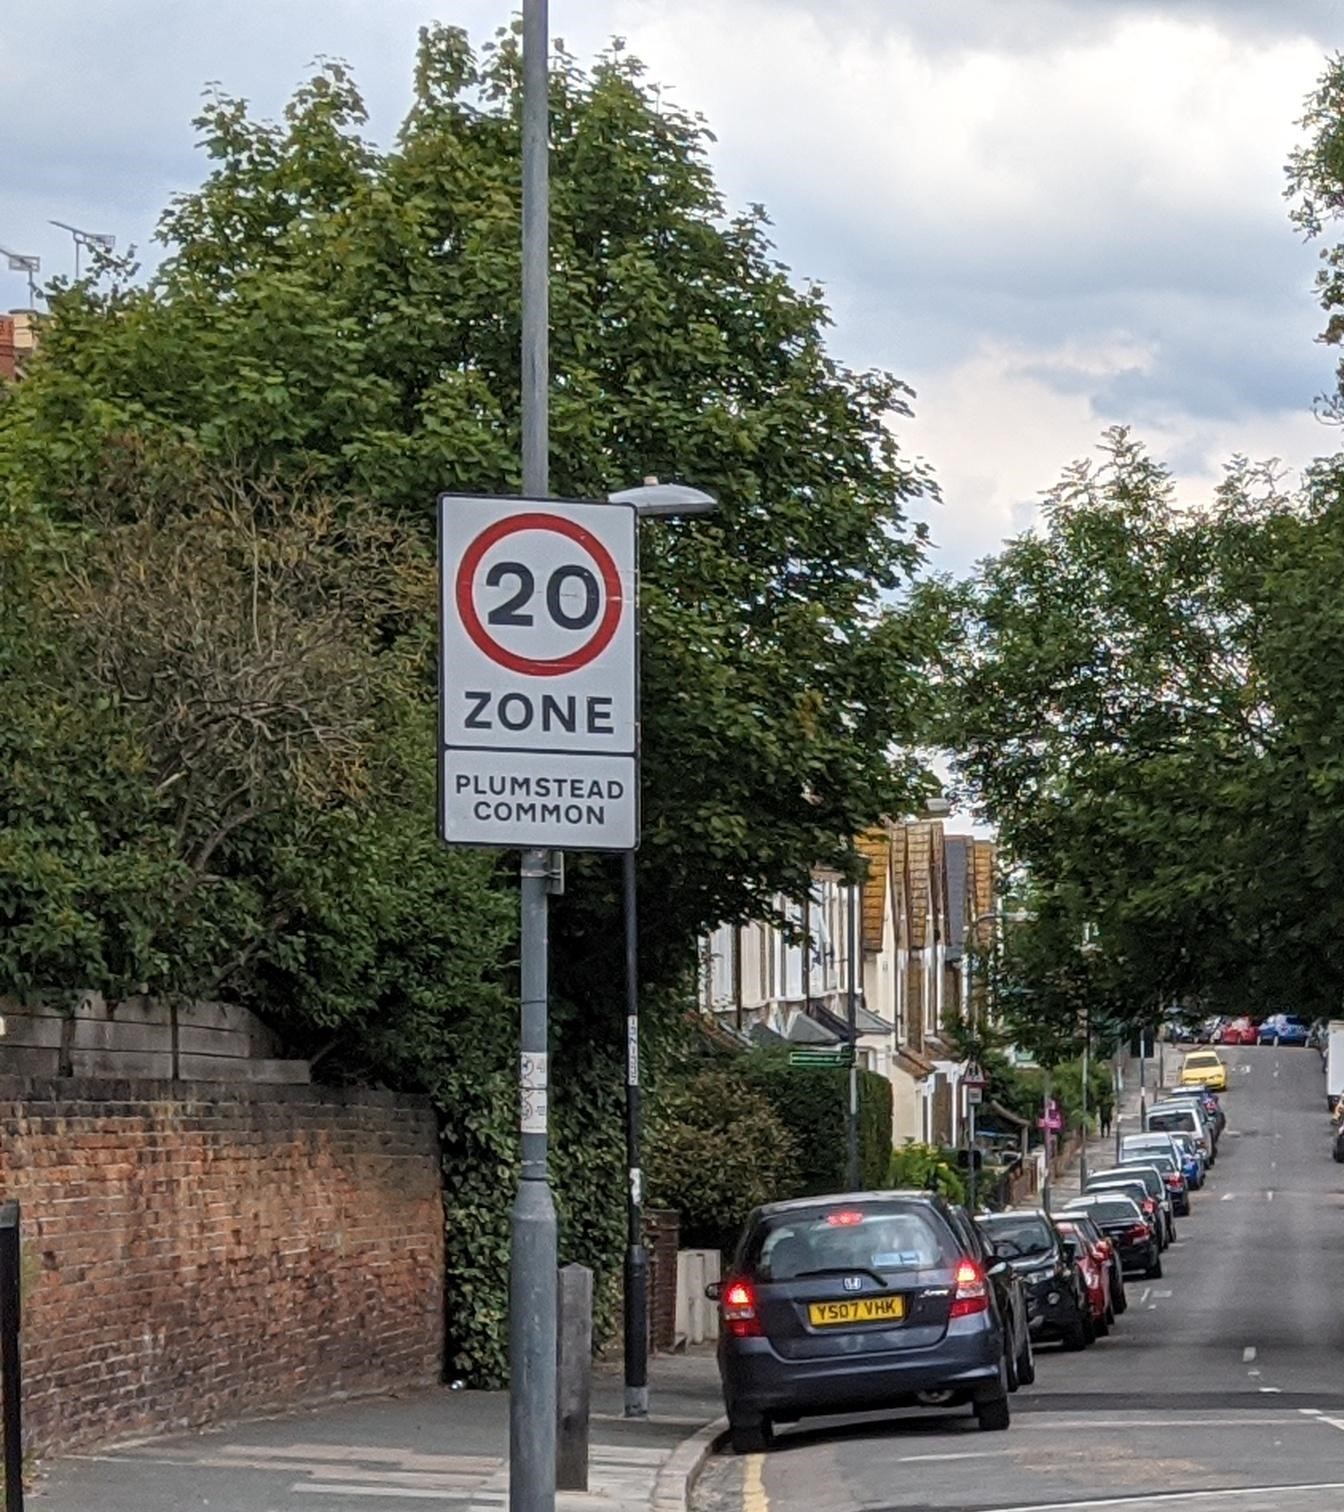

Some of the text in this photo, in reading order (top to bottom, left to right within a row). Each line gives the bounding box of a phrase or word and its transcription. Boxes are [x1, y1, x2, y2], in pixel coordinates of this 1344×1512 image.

[485, 561, 600, 631] 20
[464, 691, 615, 735] ZONE
[455, 774, 624, 800] PLUMSTEAD
[473, 801, 605, 825] COMMON
